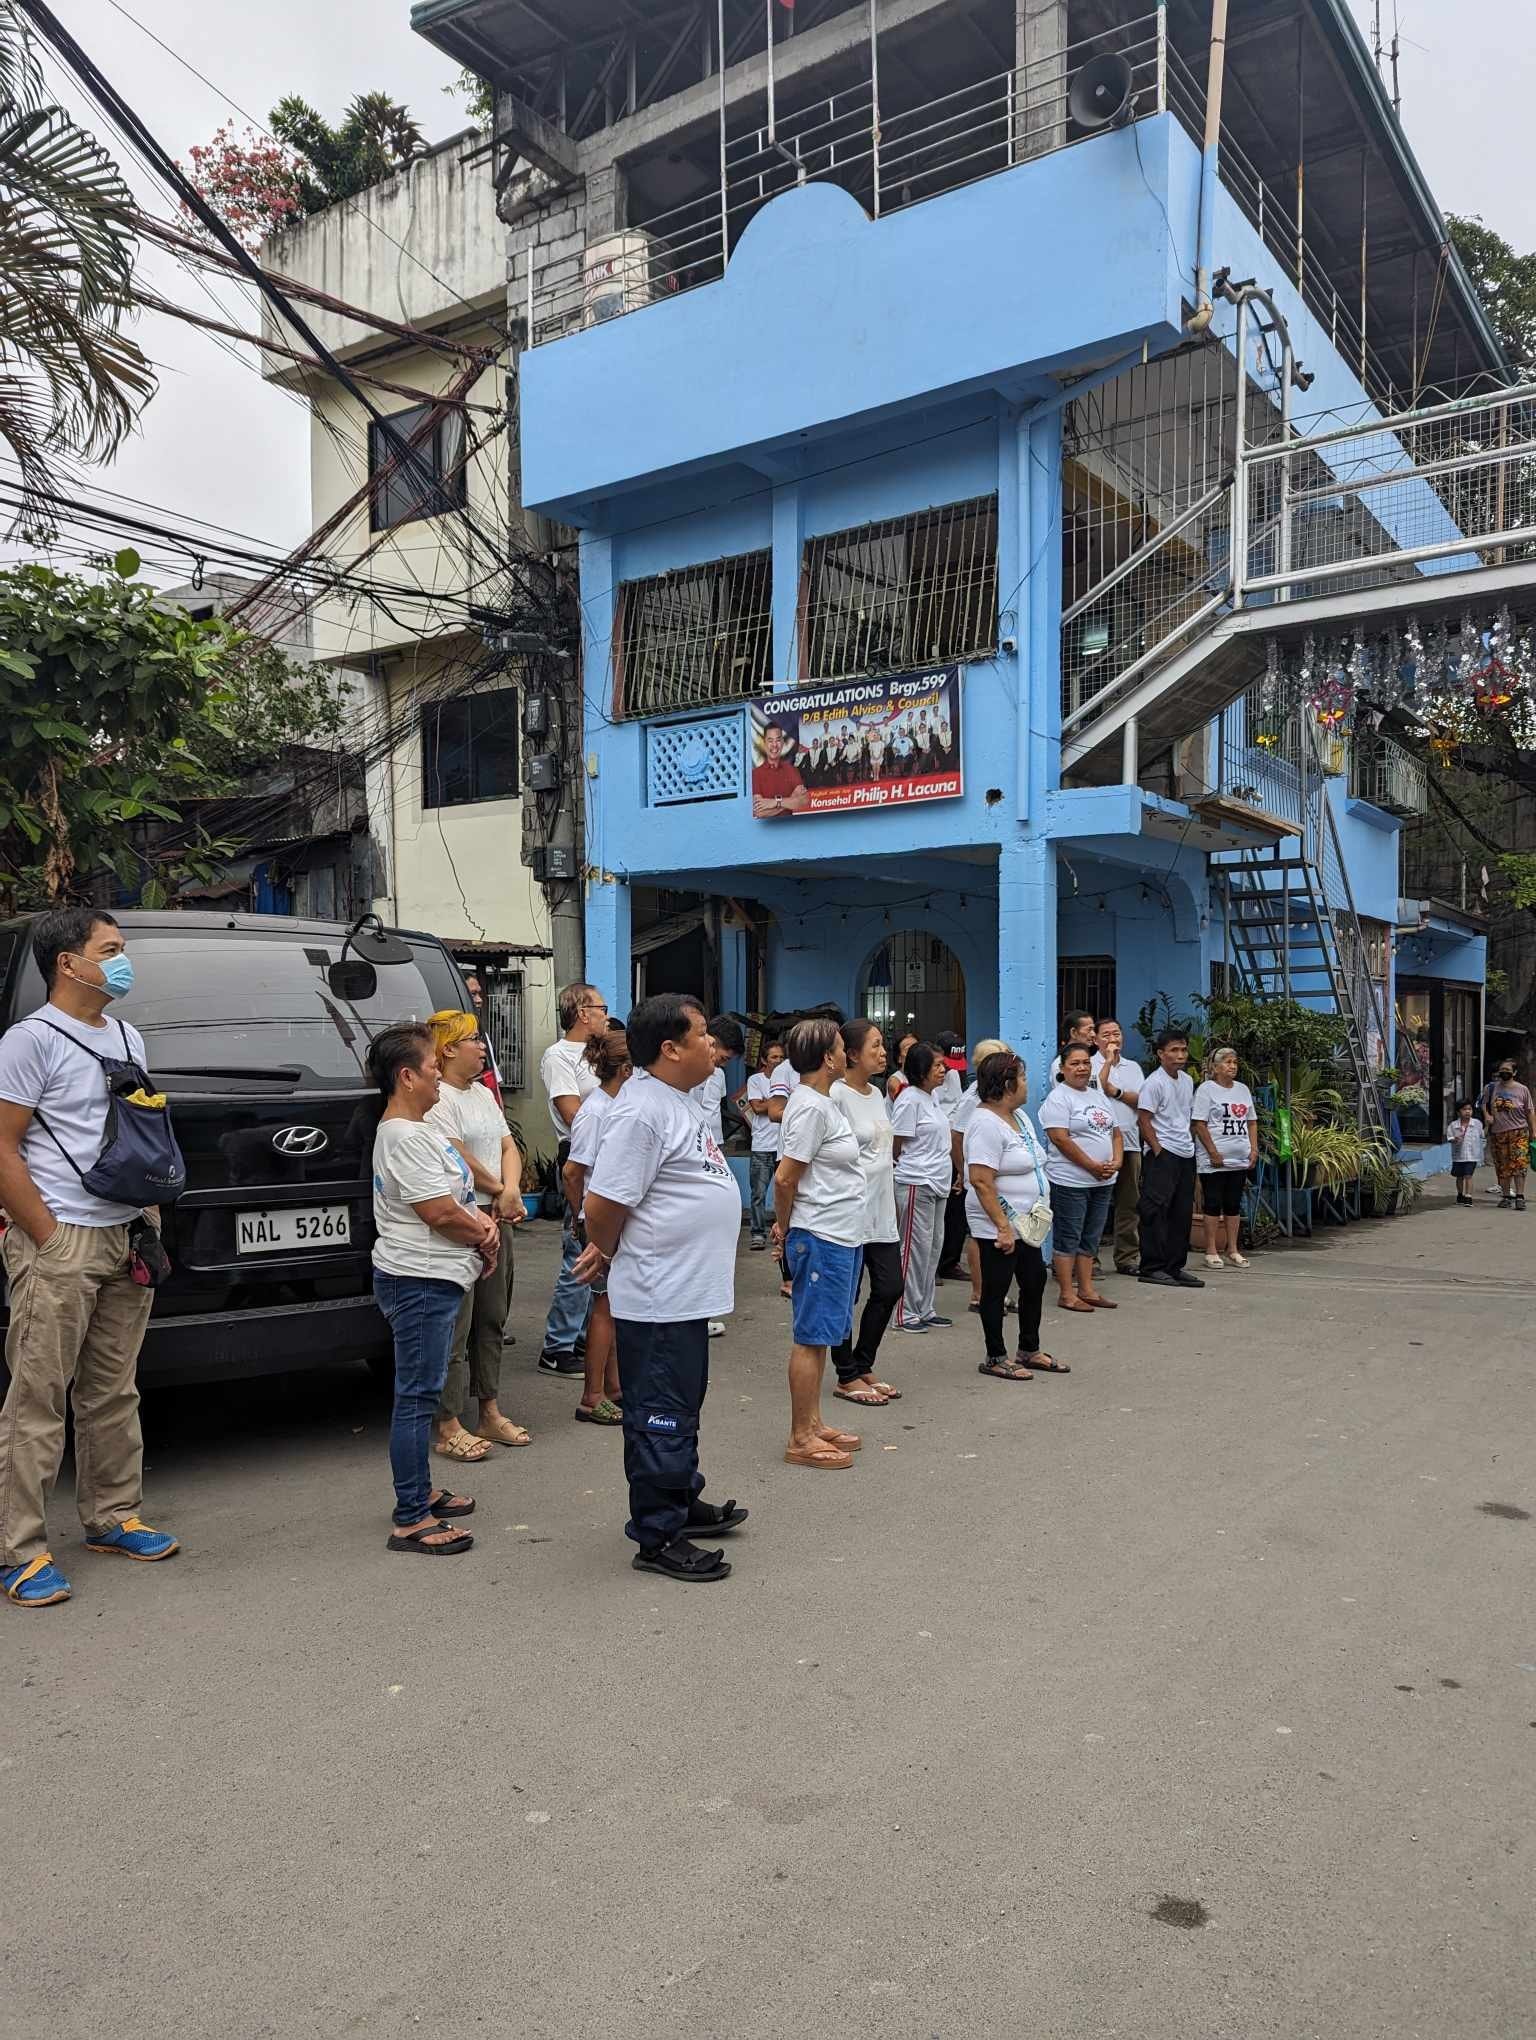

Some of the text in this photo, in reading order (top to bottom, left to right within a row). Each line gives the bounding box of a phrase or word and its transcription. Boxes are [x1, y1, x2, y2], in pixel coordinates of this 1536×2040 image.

[763, 673, 947, 715] CONGRATULATIONS Brgy.599
[802, 692, 940, 724] P/B Edith Alviso & Council
[810, 795, 851, 809] Konsehal
[853, 787, 889, 804] Philip
[891, 784, 905, 799] H.
[908, 781, 957, 797] Lacuna
[1221, 1103, 1231, 1118] I
[1222, 1119, 1247, 1136] HK
[241, 1214, 347, 1244] NAL 5266
